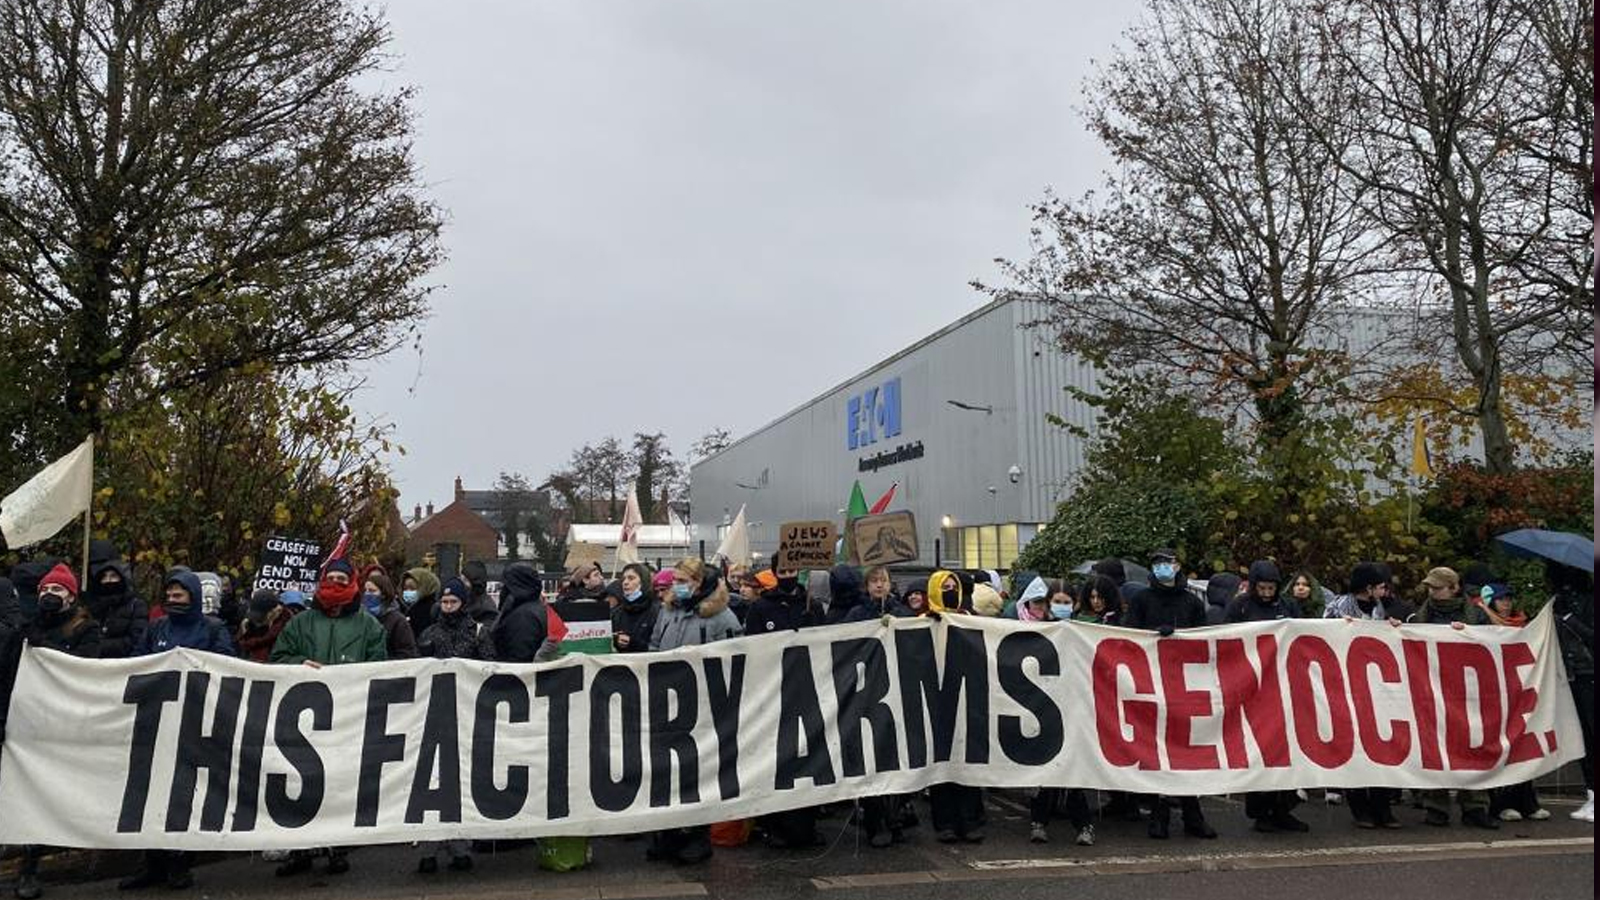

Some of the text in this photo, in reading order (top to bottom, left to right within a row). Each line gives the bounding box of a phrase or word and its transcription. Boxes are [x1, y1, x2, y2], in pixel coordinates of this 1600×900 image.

[847, 378, 901, 450] EATON
[788, 527, 828, 539] JEWS
[267, 540, 319, 555] CEASEFIRE
[284, 555, 307, 566] NOW
[262, 565, 317, 580] END THE
[259, 578, 316, 591] OCCUTION
[117, 628, 1557, 832] THIS FACTORY ARMS GENOCIDE.
